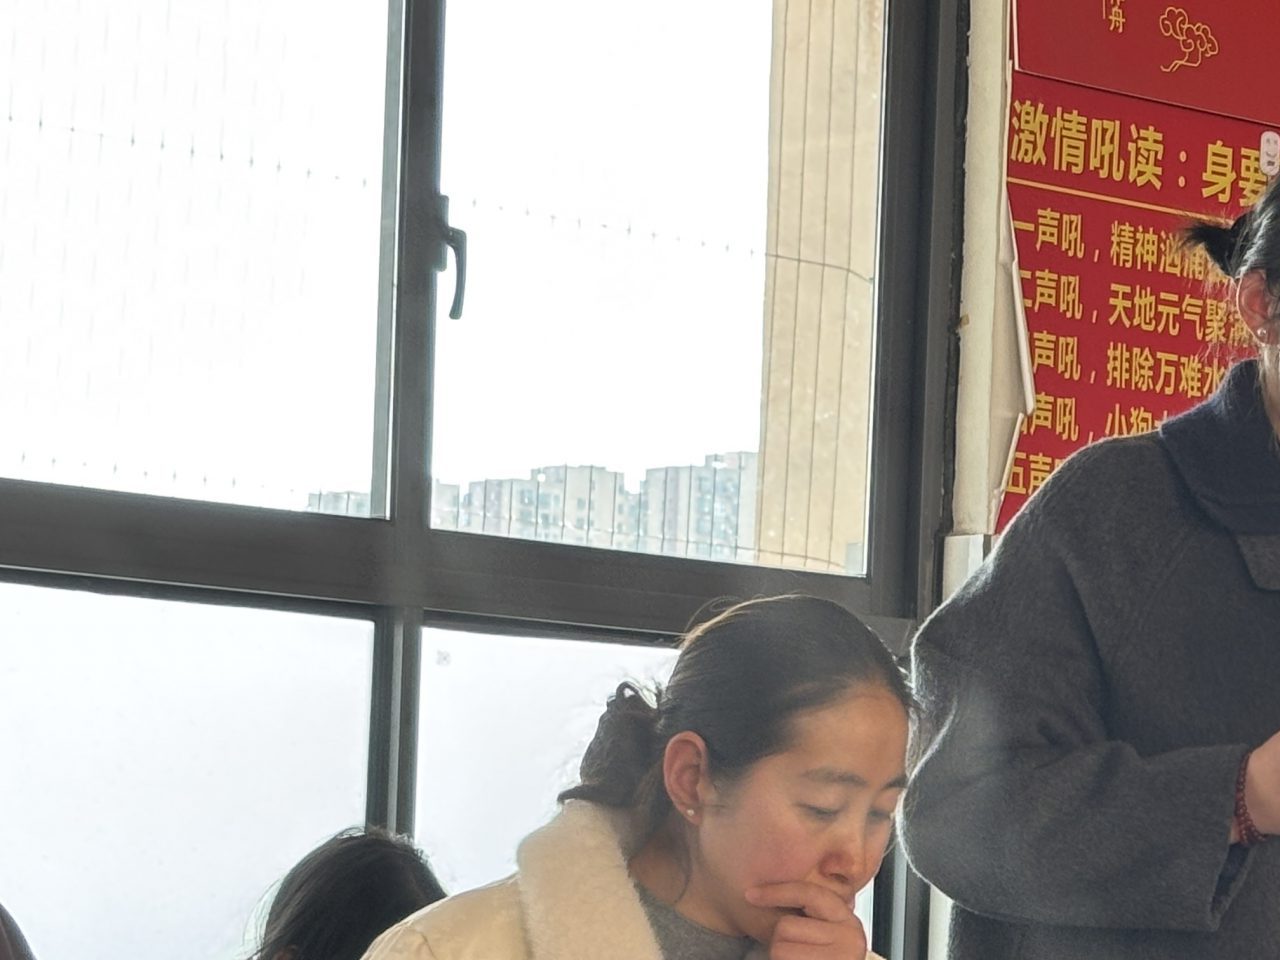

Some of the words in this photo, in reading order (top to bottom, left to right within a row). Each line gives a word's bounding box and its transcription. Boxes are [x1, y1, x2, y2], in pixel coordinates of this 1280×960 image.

[1109, 0, 1126, 33] 舟
[1012, 207, 1231, 284] 一声吼，精神汹涌
[1021, 391, 1168, 443] 声吼，小狗
[1006, 452, 1065, 495] 五声
